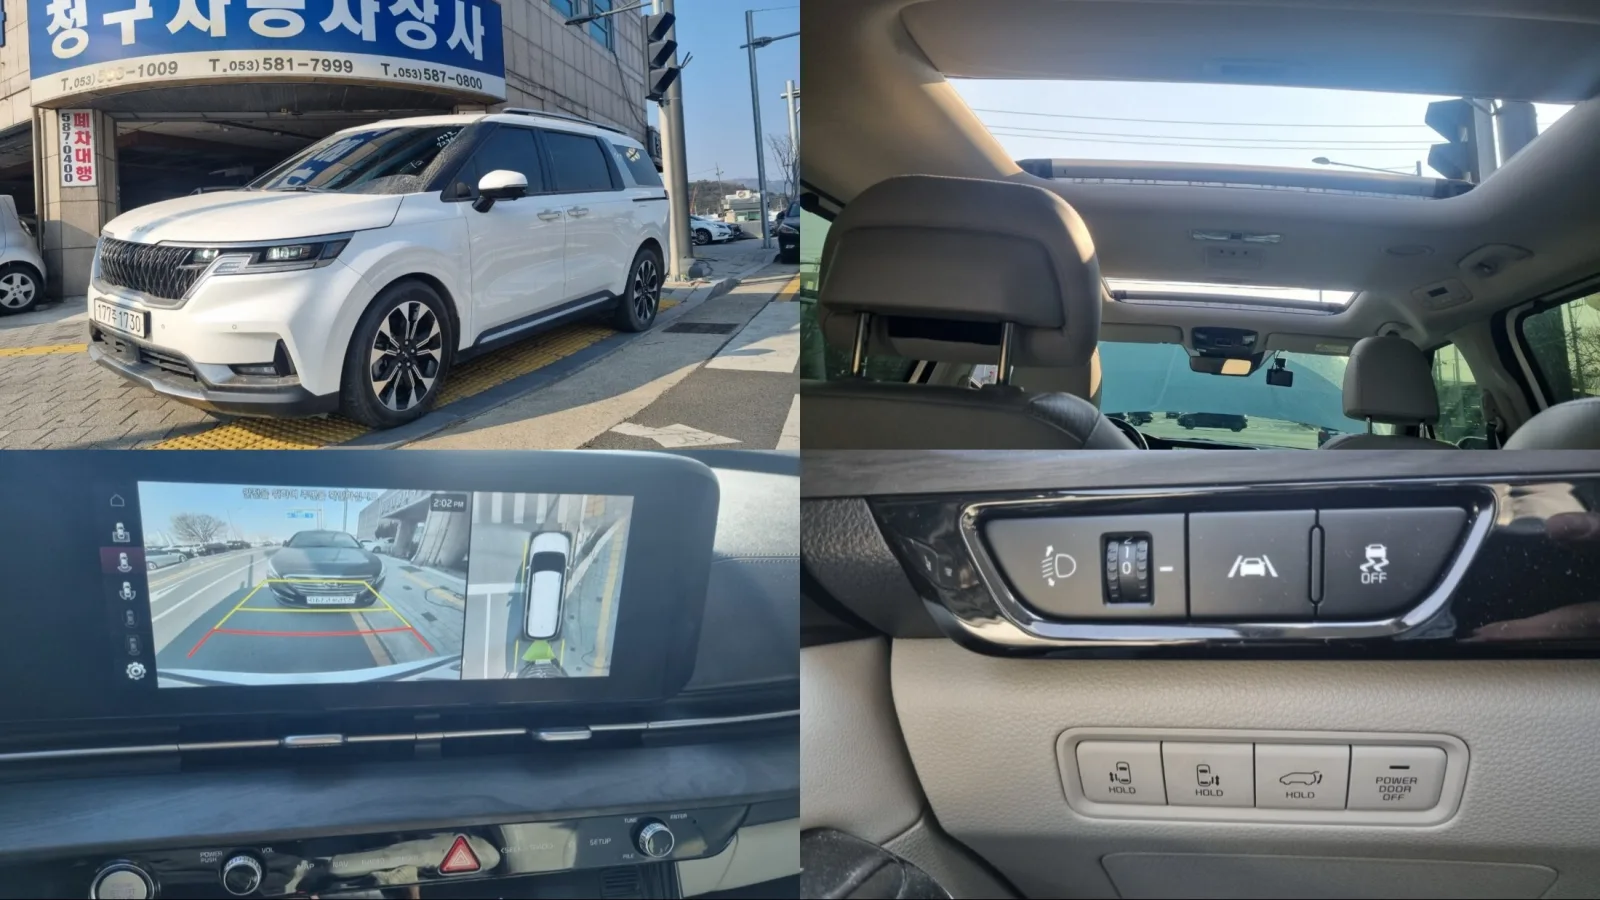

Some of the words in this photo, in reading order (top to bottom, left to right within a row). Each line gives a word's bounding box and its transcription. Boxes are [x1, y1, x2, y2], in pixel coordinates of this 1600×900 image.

[74, 112, 92, 182] 폐차대행
[433, 498, 453, 508] 2:02
[1125, 546, 1129, 558] 1
[1122, 561, 1131, 575] 0
[1361, 572, 1388, 584] OFF
[1375, 776, 1418, 784] POWER
[1108, 786, 1136, 794] HOLD
[1195, 789, 1224, 797] HOLD
[1379, 785, 1412, 793] DOOR
[1285, 791, 1315, 799] HOLD
[1382, 793, 1405, 801] OFF
[589, 838, 612, 846] SETUP
[200, 850, 223, 858] POWER
